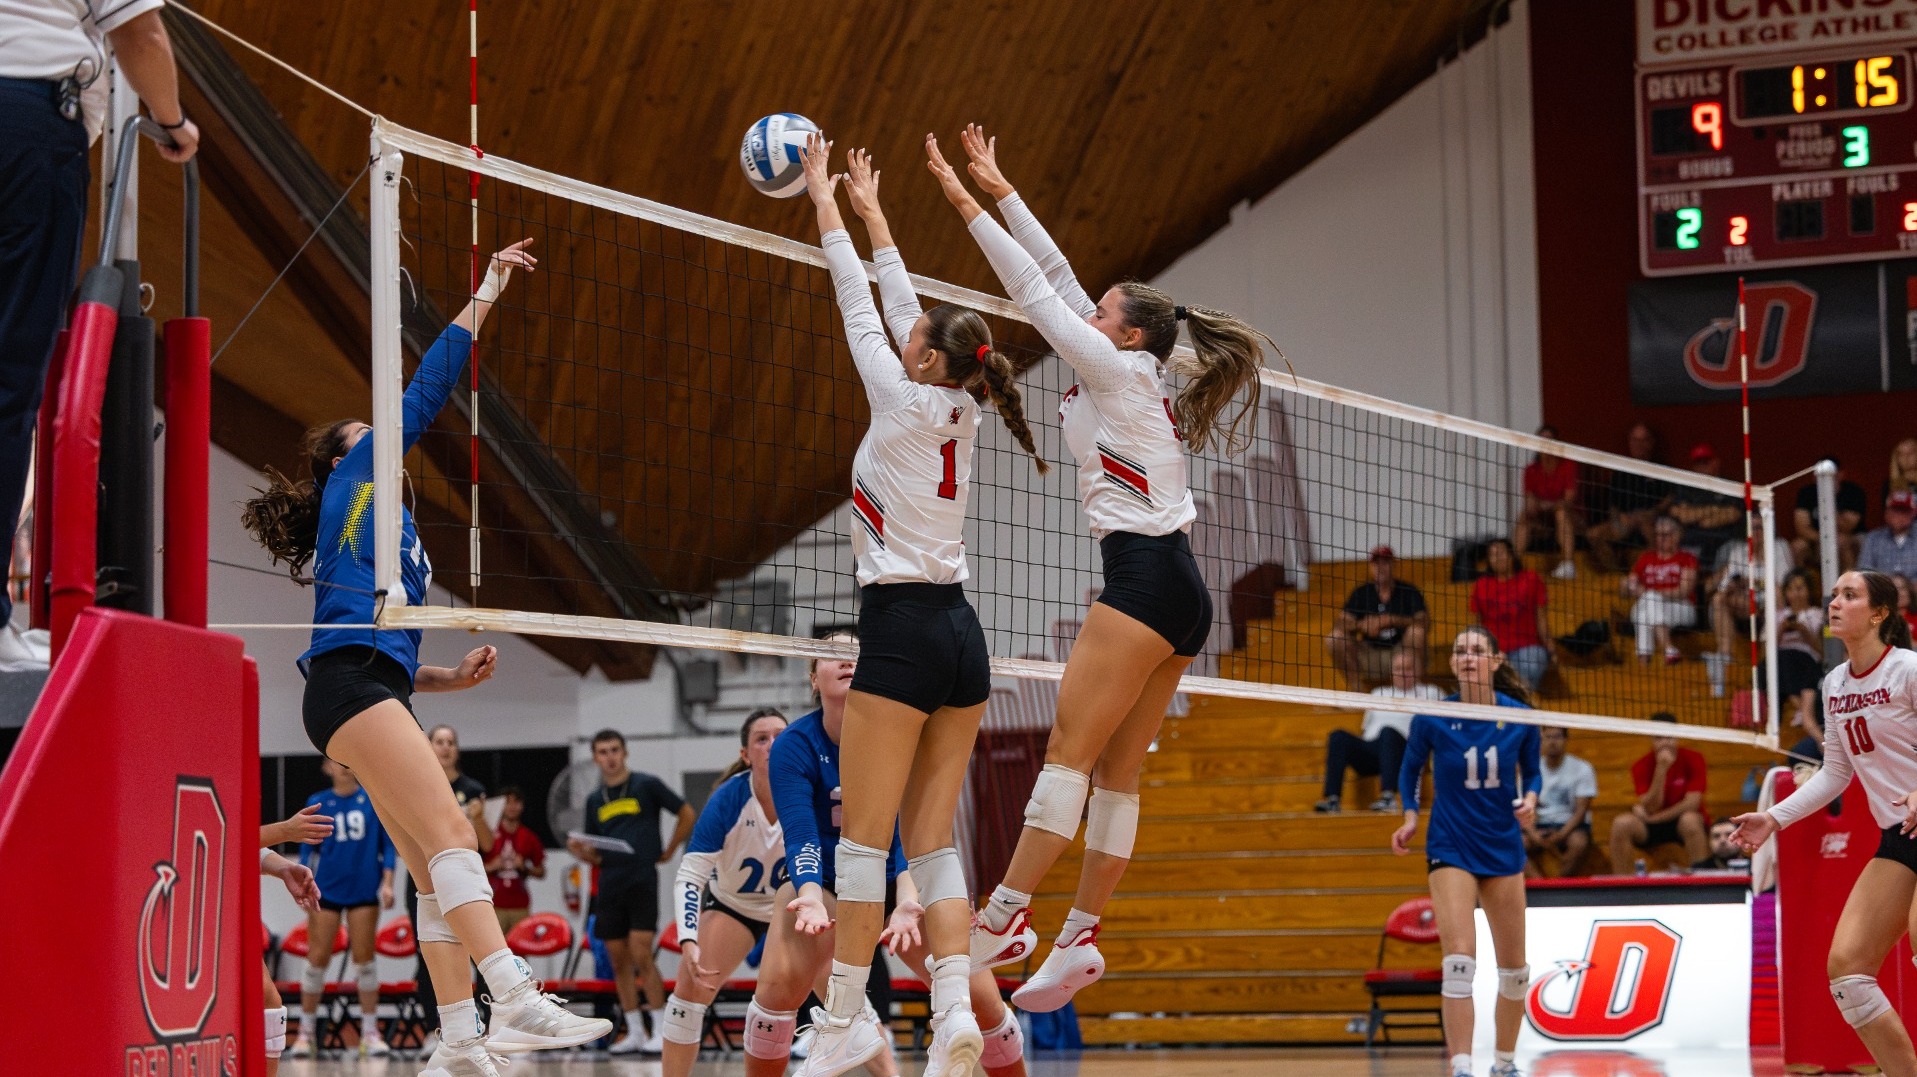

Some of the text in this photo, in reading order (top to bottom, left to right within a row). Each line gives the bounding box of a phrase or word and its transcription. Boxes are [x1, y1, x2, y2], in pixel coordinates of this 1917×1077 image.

[1654, 9, 1917, 54] COLLEGE ATHLE
[1648, 71, 1722, 101] DEVILS
[1791, 56, 1898, 113] 1:15
[1692, 102, 1722, 150] 9
[1843, 125, 1869, 168] 3
[1676, 208, 1702, 249] 2
[1729, 216, 1748, 246] 2
[1904, 202, 1917, 231] 2
[937, 438, 958, 500] 1
[1844, 716, 1875, 756] 10
[1463, 745, 1501, 790] 11
[334, 809, 366, 842] 19
[684, 881, 700, 931] COUGS
[1526, 919, 1683, 1042] D
